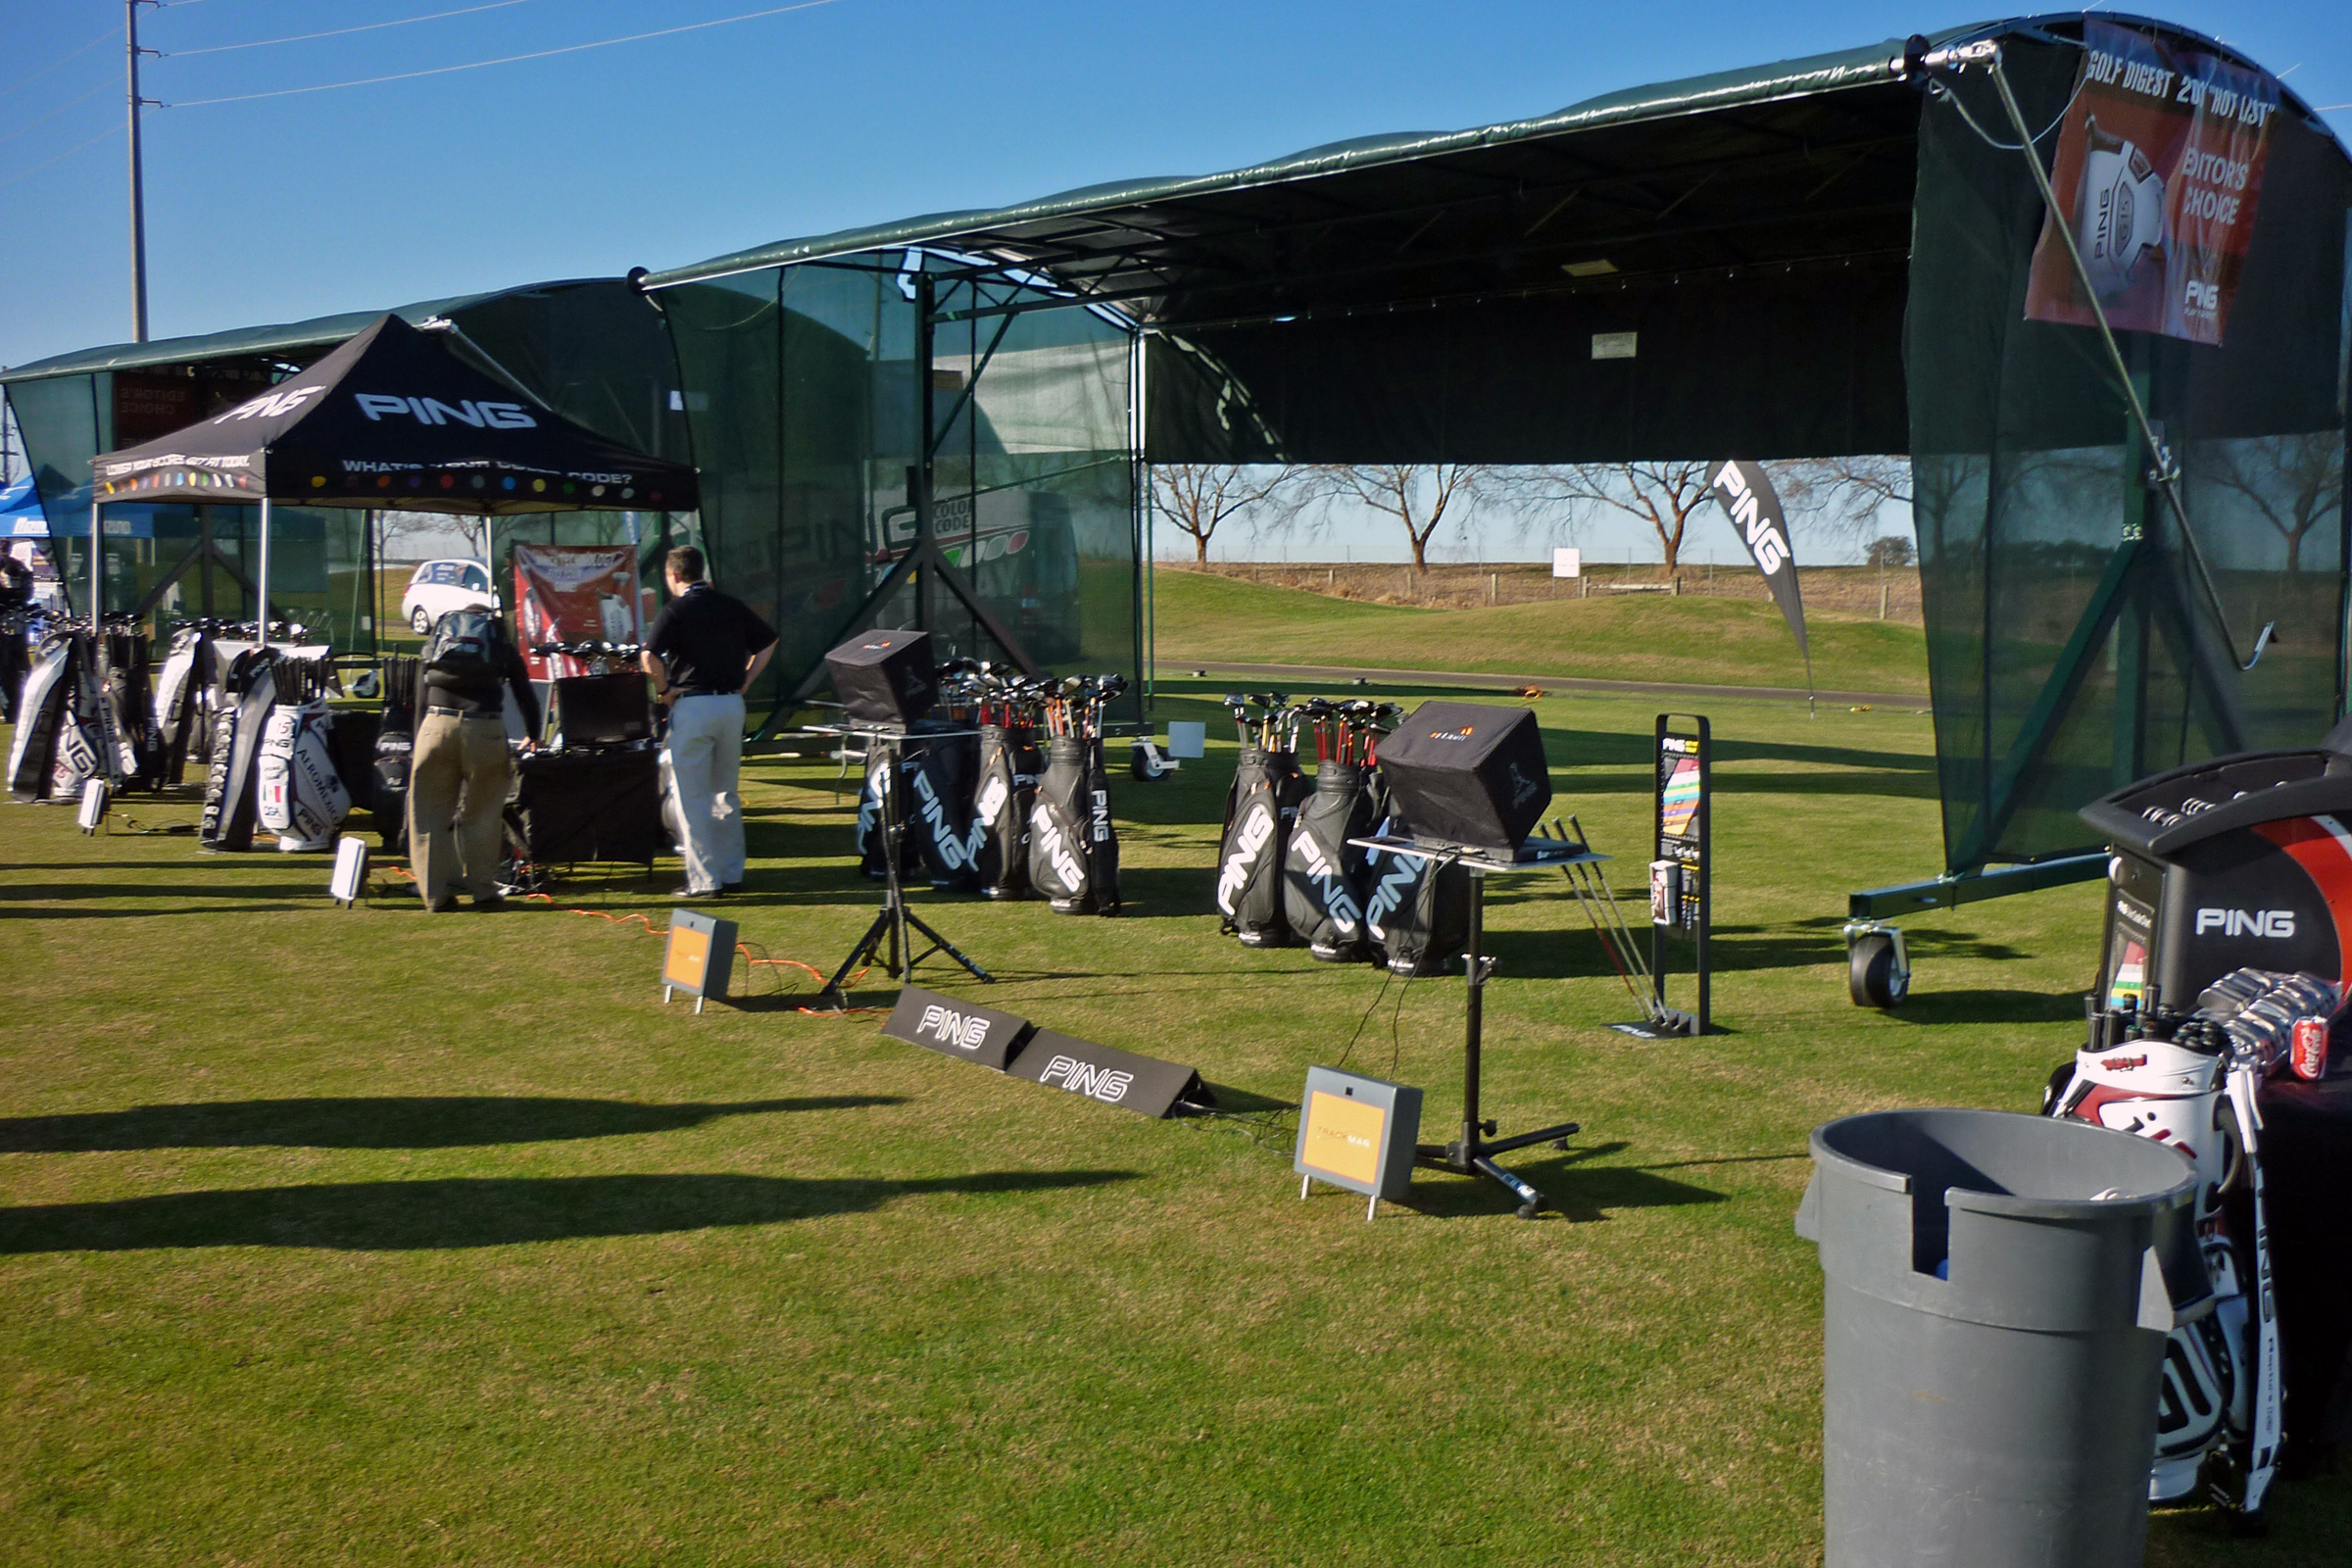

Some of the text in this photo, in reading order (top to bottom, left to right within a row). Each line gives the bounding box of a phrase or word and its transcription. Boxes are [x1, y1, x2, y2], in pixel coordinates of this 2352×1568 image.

[2085, 50, 2124, 85] GOLF
[2122, 61, 2175, 98] DIGEST
[2094, 188, 2110, 259] PING
[214, 385, 327, 424] PING
[355, 393, 537, 429] PING
[935, 514, 971, 533] CODE
[1713, 460, 1788, 575] PING
[379, 741, 412, 753] PING
[1013, 773, 1044, 787] PIN
[913, 769, 967, 870] PING
[965, 776, 1008, 872] PING
[1091, 789, 1110, 843] PING
[1032, 804, 1085, 893] PING
[1218, 807, 1274, 916] PING
[1291, 831, 1362, 933] PING
[2195, 907, 2295, 938] PING
[916, 1004, 990, 1050] PING
[1040, 1054, 1134, 1102] PING
